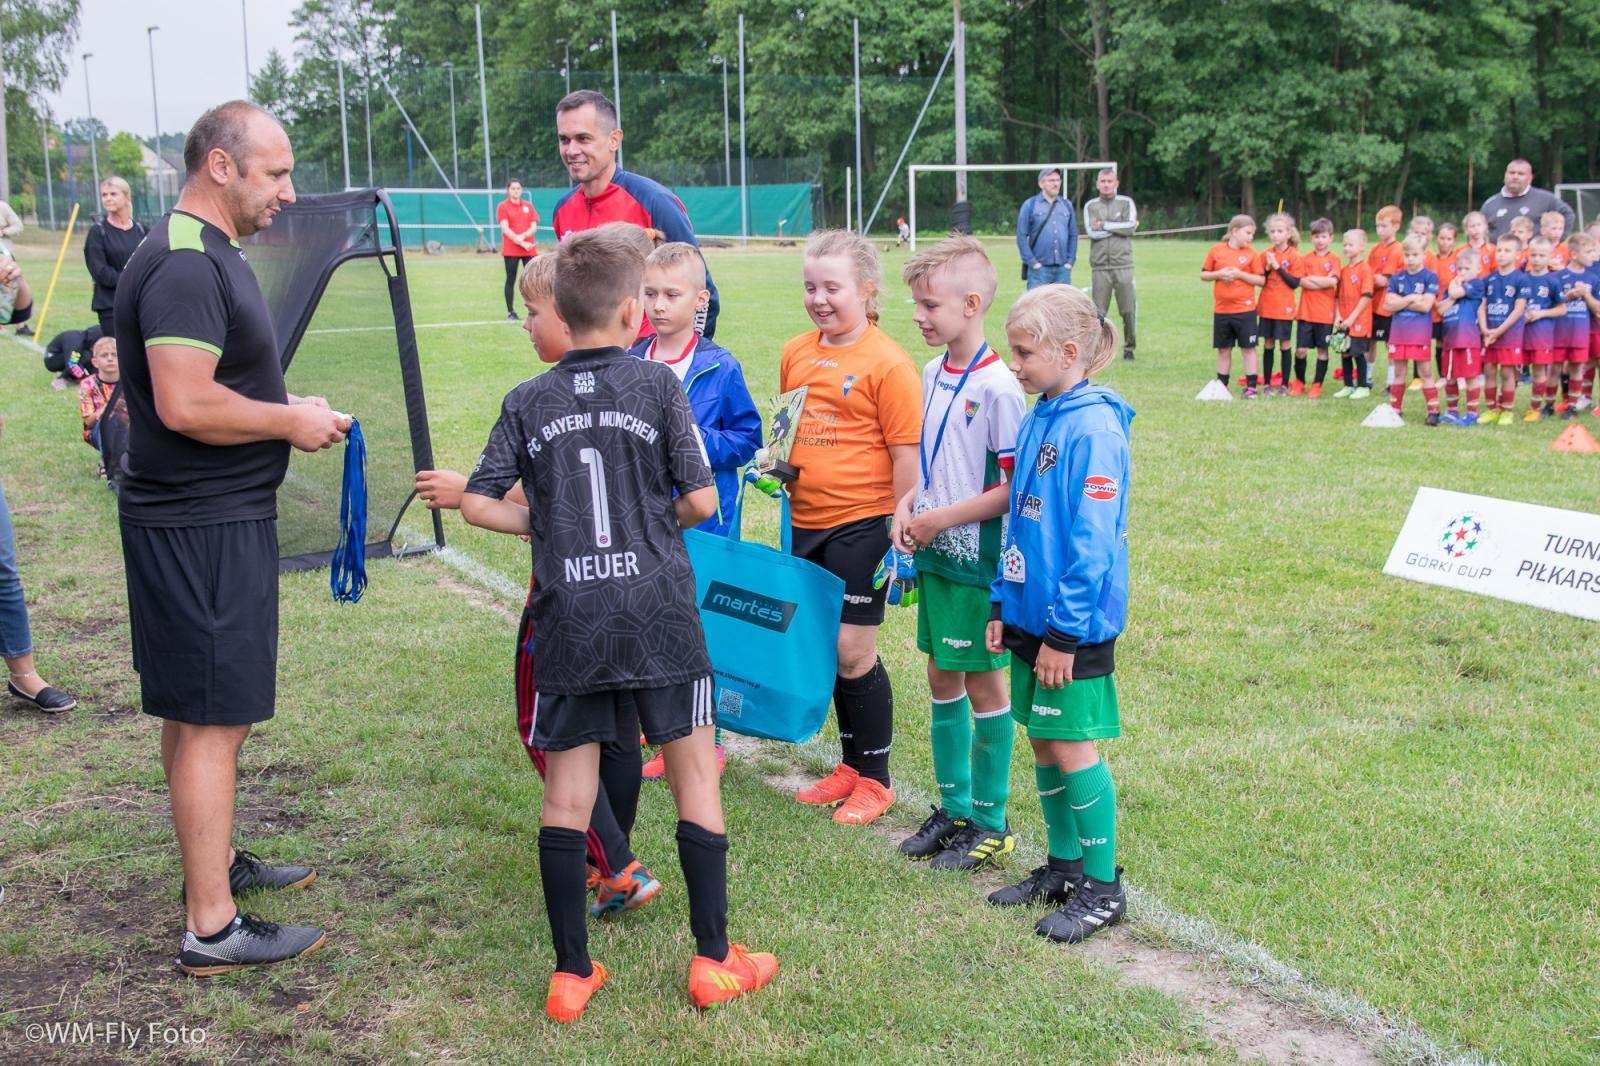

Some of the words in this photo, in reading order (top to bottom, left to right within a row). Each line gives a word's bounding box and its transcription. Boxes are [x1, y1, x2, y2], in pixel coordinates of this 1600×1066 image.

[574, 371, 595, 380] MIA
[573, 379, 596, 387] SAN
[575, 386, 595, 395] MIA
[526, 437, 543, 459] FC
[541, 411, 593, 442] BAYERN
[599, 411, 659, 445] MÜNCHEN
[797, 422, 837, 438] NTRUM
[1083, 482, 1118, 493] BOWIM
[579, 447, 612, 549] 1
[563, 551, 640, 583] NEUER
[1405, 552, 1454, 573] GÓRKI
[1457, 564, 1493, 580] CUP
[843, 593, 873, 605] egio
[712, 593, 783, 622] martes
[942, 636, 973, 649] regio
[1031, 704, 1062, 716] egio
